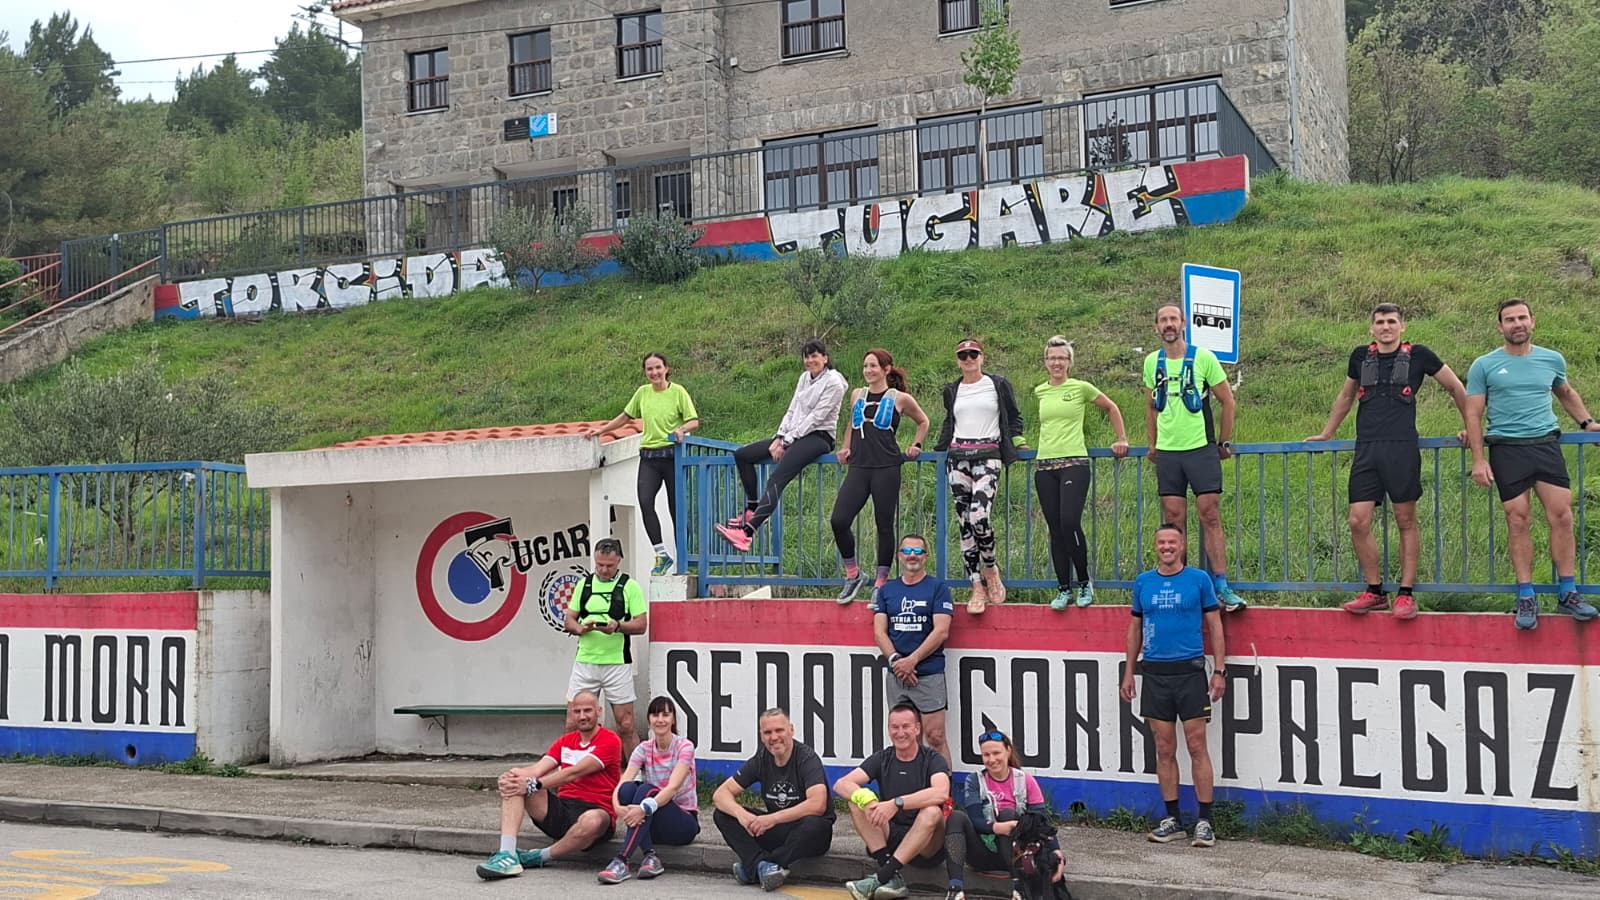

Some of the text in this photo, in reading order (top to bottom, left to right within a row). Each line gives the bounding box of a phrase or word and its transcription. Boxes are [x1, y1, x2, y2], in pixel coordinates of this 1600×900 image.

[767, 164, 1188, 259] TUGARE
[464, 505, 624, 592] TUGAR
[912, 615, 928, 623] 100
[43, 634, 186, 727] MORA
